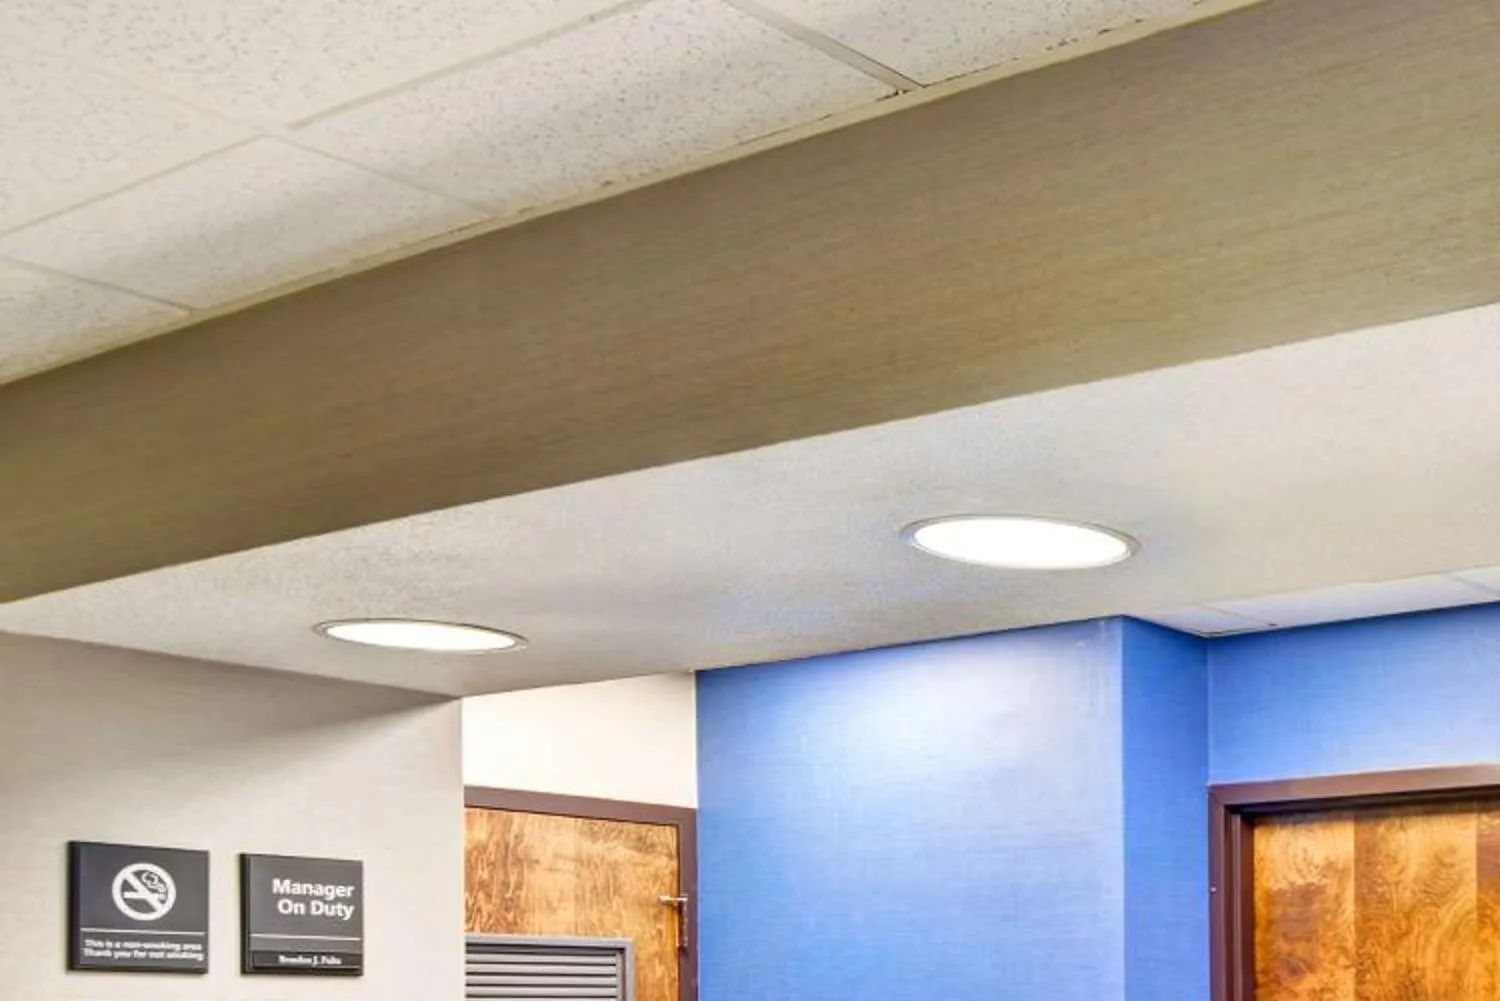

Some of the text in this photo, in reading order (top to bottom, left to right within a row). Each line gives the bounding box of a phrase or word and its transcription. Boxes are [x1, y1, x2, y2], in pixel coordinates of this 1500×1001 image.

[272, 878, 355, 900] Manager
[277, 899, 355, 921] On Duty
